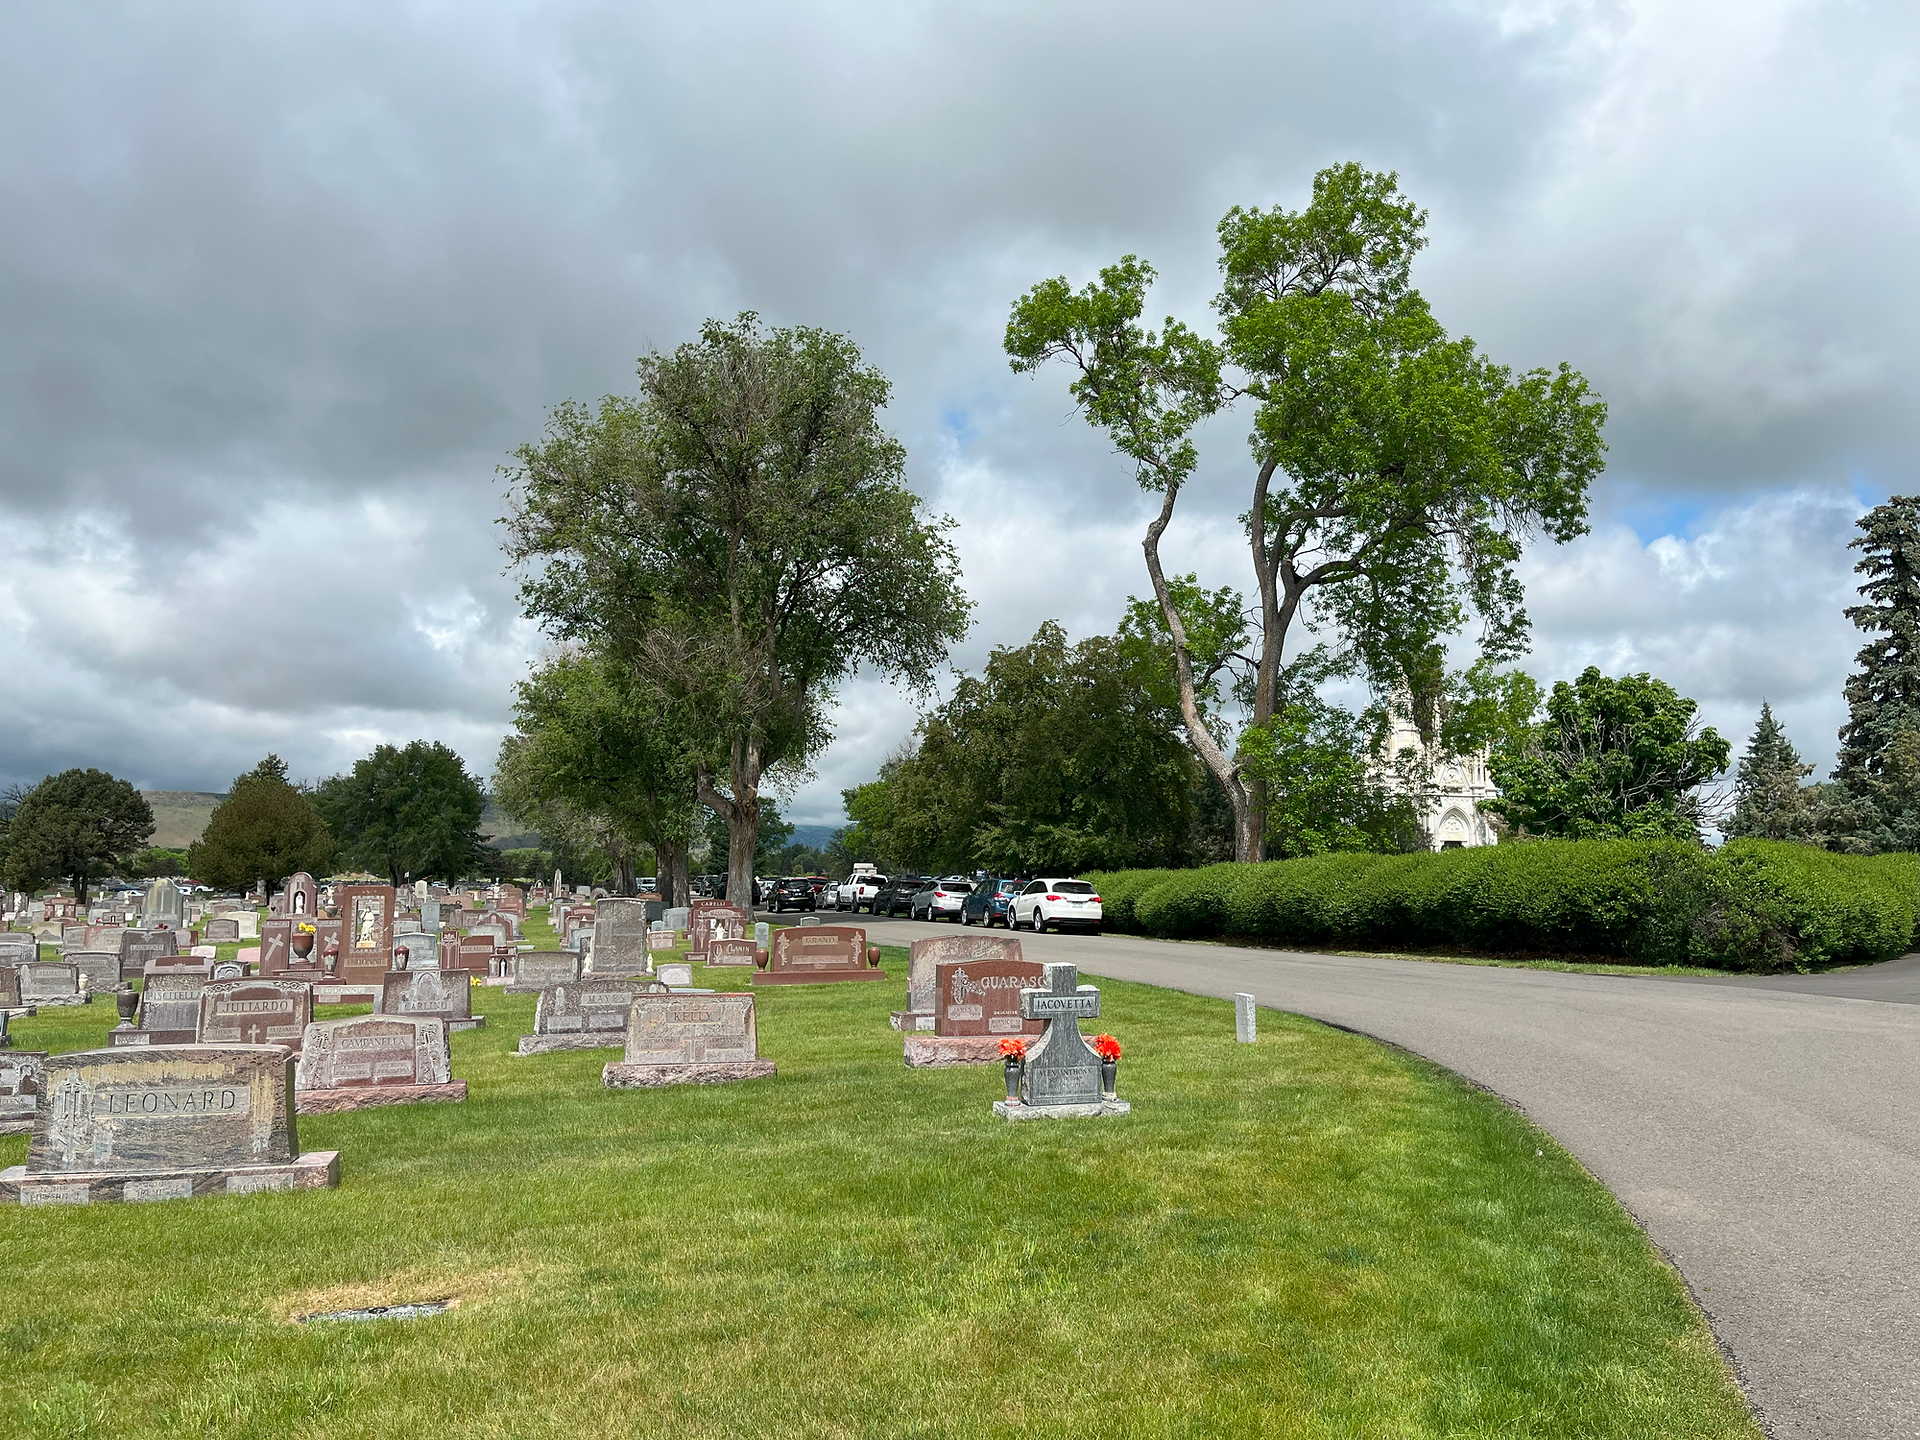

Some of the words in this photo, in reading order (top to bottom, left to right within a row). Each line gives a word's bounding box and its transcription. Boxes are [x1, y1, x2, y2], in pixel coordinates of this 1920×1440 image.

[588, 994, 625, 1002] HAYES
[222, 1001, 288, 1013] JULIARDO
[405, 1002, 448, 1010] CARLINO
[1037, 999, 1092, 1009] IACOVETTA
[674, 1012, 712, 1021] KELLY
[341, 1037, 406, 1048] CAMPANELLA
[108, 1089, 236, 1114] LEONARD
